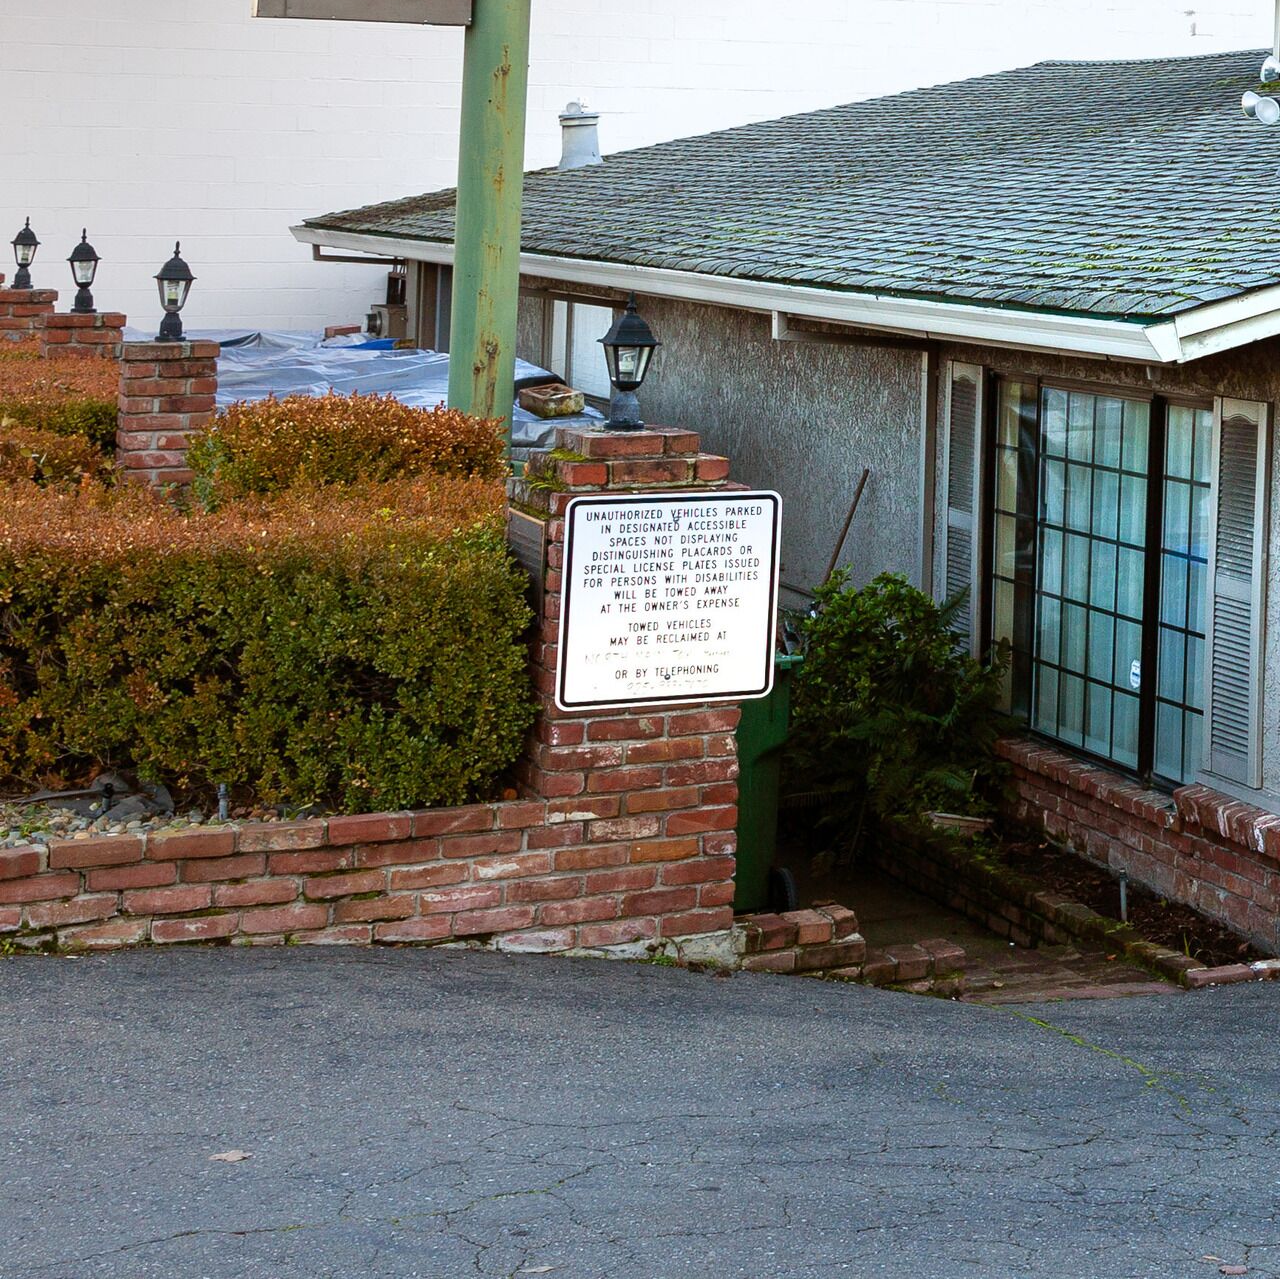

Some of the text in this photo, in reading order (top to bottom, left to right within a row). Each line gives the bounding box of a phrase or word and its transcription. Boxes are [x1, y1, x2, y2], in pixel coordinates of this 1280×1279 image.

[586, 506, 762, 521] UNAUTHORIZED VEHICLES PARKED
[601, 520, 747, 534] IN DESIGNATED ACCESSIBLE
[609, 533, 738, 547] SPACES NOT DISPLAYING
[592, 545, 753, 561] DISTINGUISHING PLACARDS OR
[584, 558, 760, 575] SPECIAL LICENSE PLATES ISSUED
[583, 571, 758, 588] FOR PERSONS WITH DISABILITIES
[614, 585, 728, 600] WILL BE TOWED AWAY
[600, 598, 740, 614] AT THE OWNER'S EXPENSE
[628, 619, 712, 633] TOWED VEHICLES
[609, 631, 727, 647] MAY BE RECLAIMED AT
[615, 664, 719, 680] OR BY TELEPHONING
